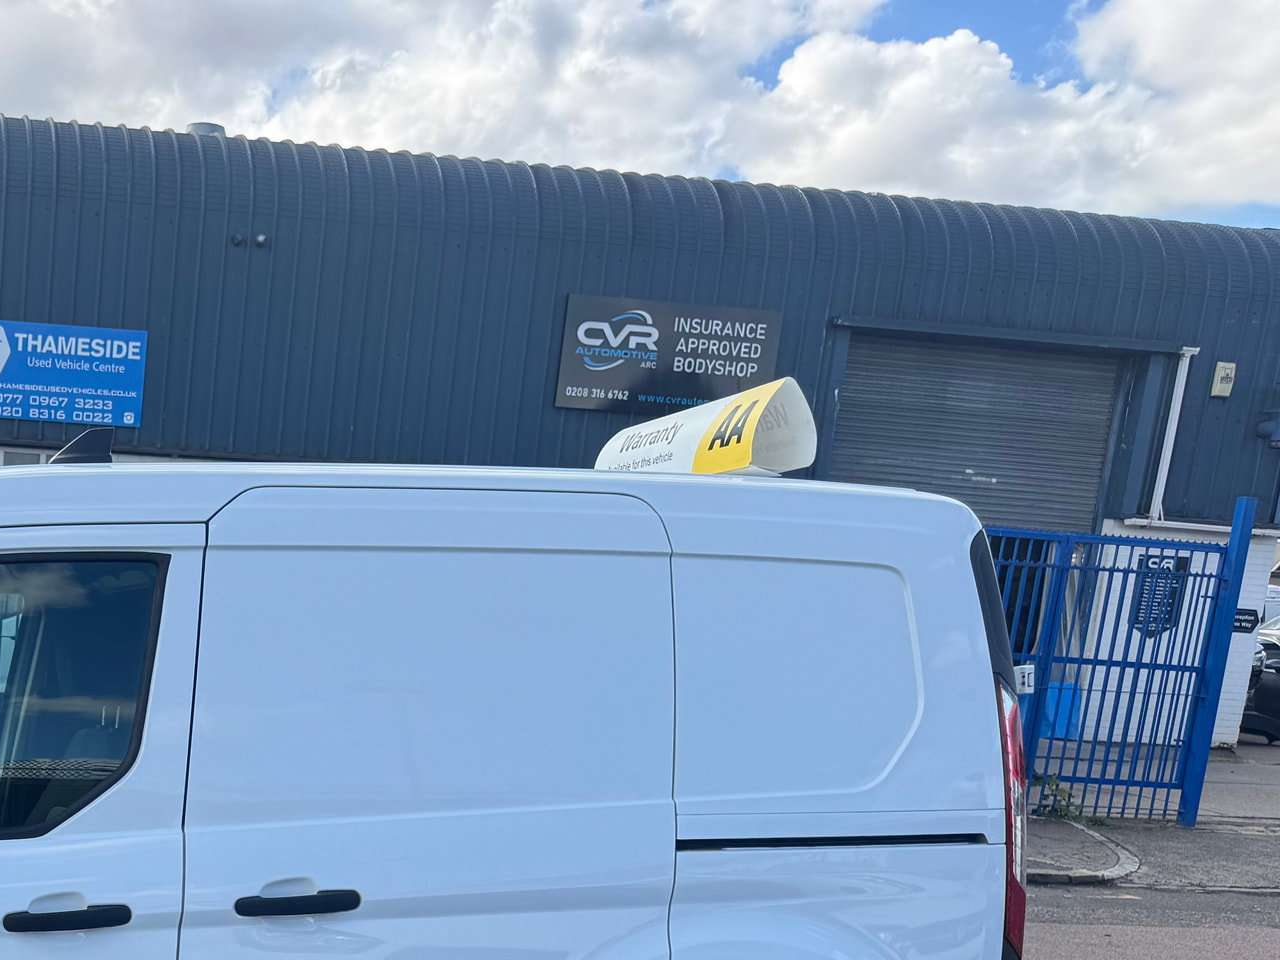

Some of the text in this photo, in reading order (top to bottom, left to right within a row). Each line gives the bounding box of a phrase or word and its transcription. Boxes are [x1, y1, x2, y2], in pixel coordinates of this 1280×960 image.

[576, 320, 660, 351] CVR
[673, 317, 768, 340] INSURANCE
[14, 333, 142, 361] THAMESIDE
[575, 346, 658, 361] AUTOMOTIVE
[675, 337, 762, 359] APPROVED
[27, 356, 126, 374] Used Vehicle Centre
[640, 361, 657, 369] ARC
[672, 356, 759, 378] BODYSHOP
[29, 395, 69, 407] 0967
[74, 398, 113, 411] 3233
[565, 386, 629, 401] 0208 316 6762
[638, 394, 706, 406] www.cvrauto
[29, 408, 66, 420] 8316
[72, 411, 113, 423] 0022
[708, 399, 760, 451] AA
[620, 421, 684, 453] Warranty
